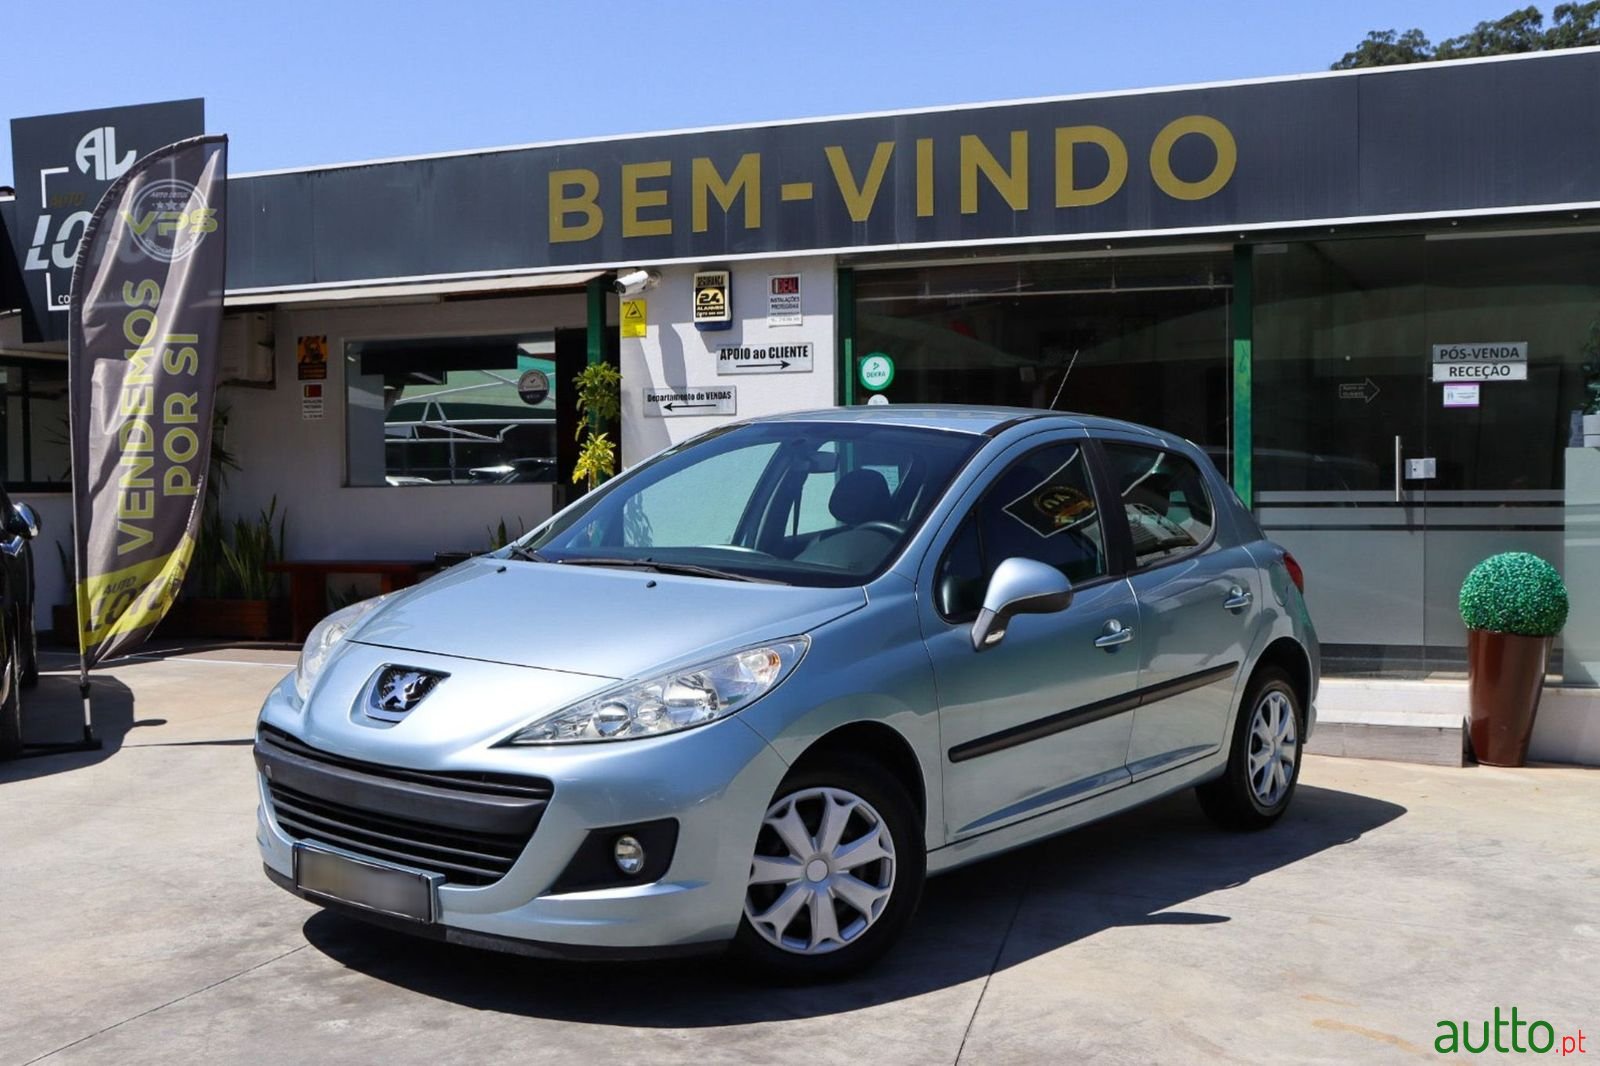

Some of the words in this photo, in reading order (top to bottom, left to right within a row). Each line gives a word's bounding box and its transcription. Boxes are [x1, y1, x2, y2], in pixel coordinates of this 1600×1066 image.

[75, 126, 137, 180] AL
[548, 115, 1237, 243] BEM-VINDO
[121, 207, 218, 236] VPS
[699, 292, 720, 304] 24
[163, 333, 199, 377] SI
[720, 347, 750, 360] APOIO
[753, 349, 766, 360] ao
[769, 345, 808, 359] CLIENTE
[1440, 346, 1520, 360] PÓS-VENDA
[1449, 362, 1511, 379] RECEÇÃO
[647, 392, 695, 402] Departamento
[696, 392, 705, 401] de
[706, 391, 732, 400] VENDAS
[117, 278, 161, 556] VENDEMOS
[163, 392, 199, 496] POR
[104, 576, 137, 595] AUTO
